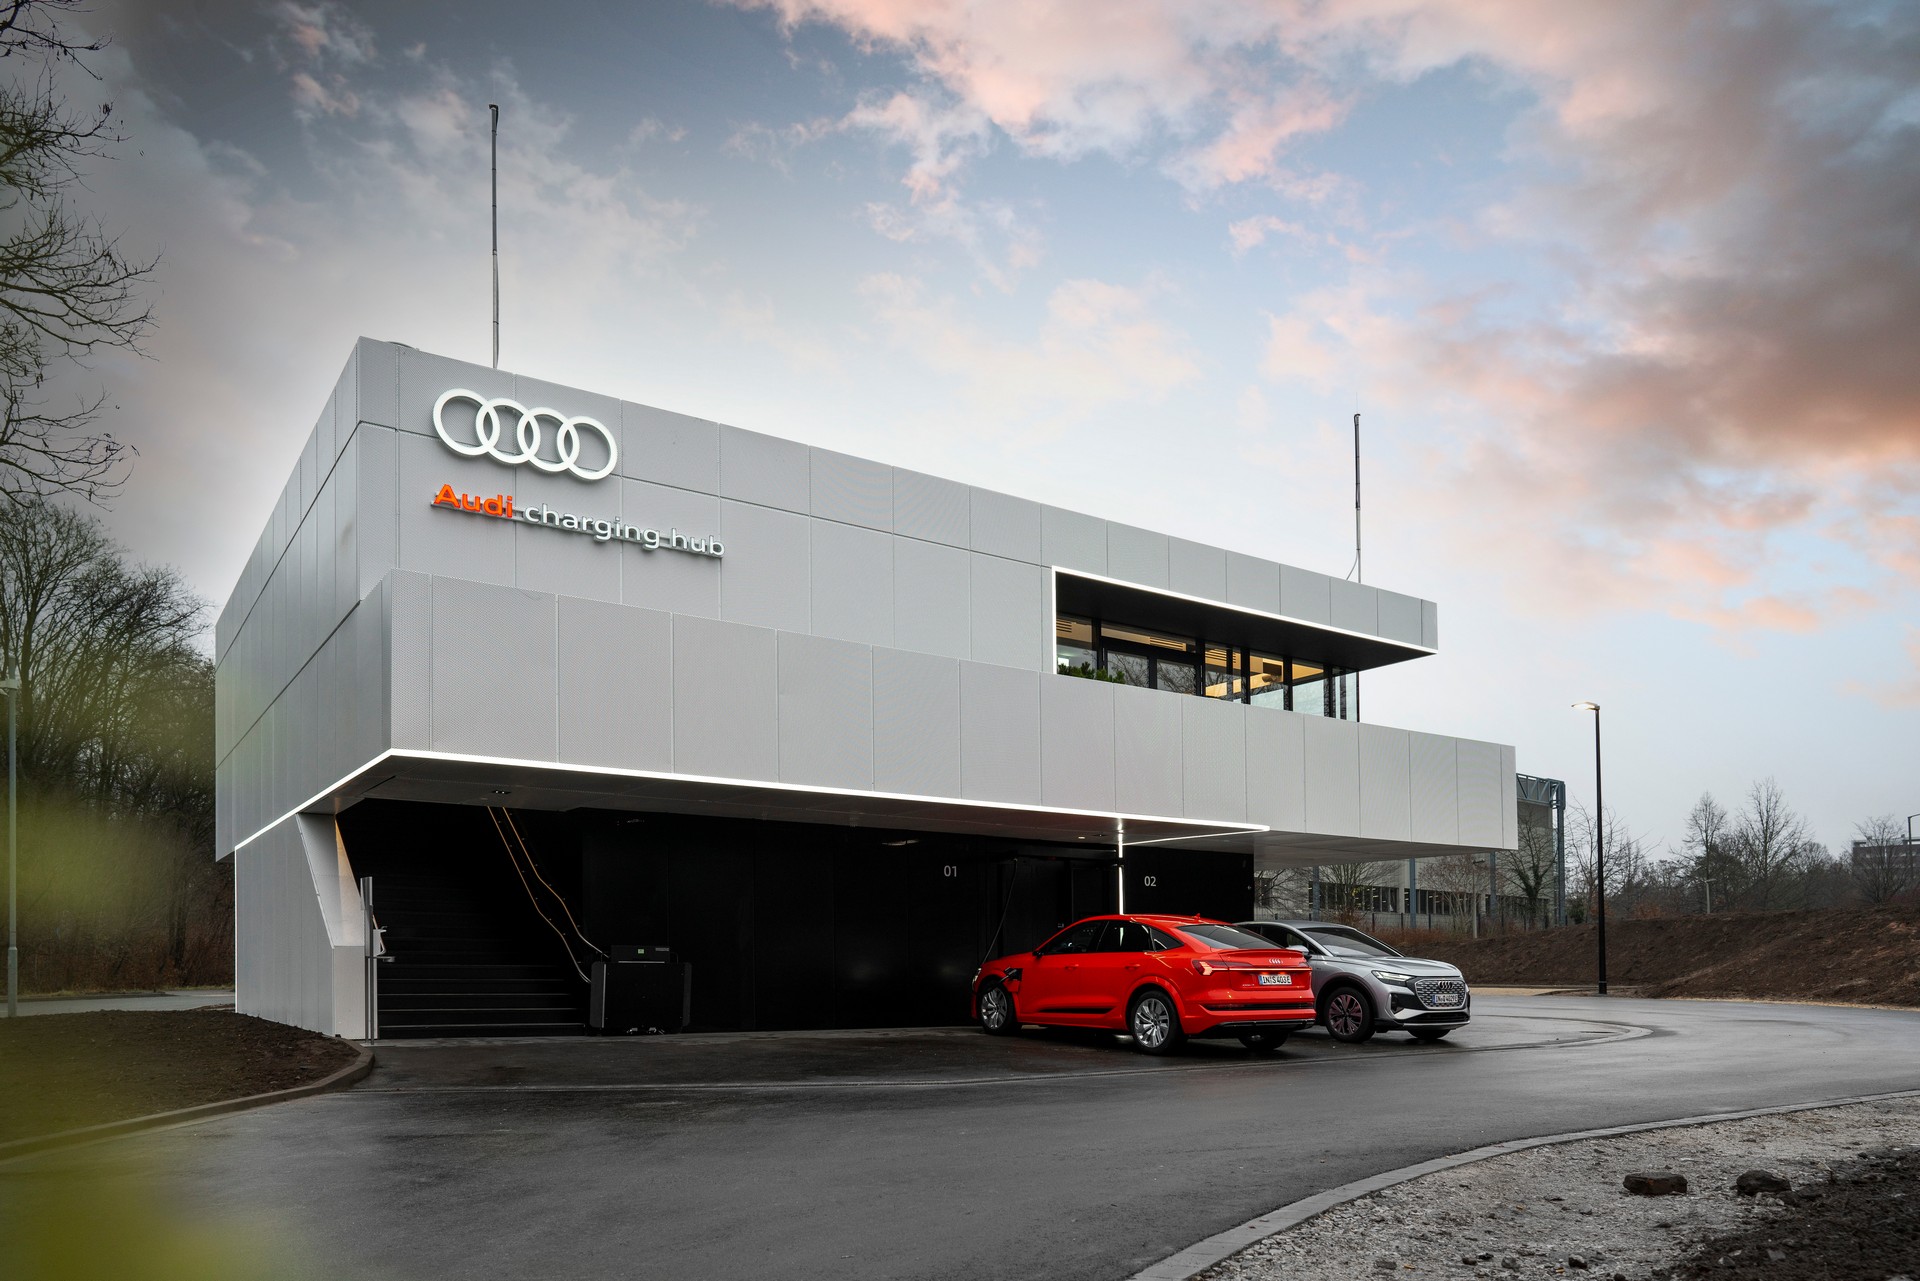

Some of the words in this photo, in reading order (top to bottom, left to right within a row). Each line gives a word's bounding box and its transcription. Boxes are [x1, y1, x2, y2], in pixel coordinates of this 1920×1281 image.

[433, 483, 513, 518] Audi
[523, 503, 660, 550] charging
[671, 528, 725, 557] hub
[943, 865, 957, 878] 01
[1144, 876, 1157, 887] 02
